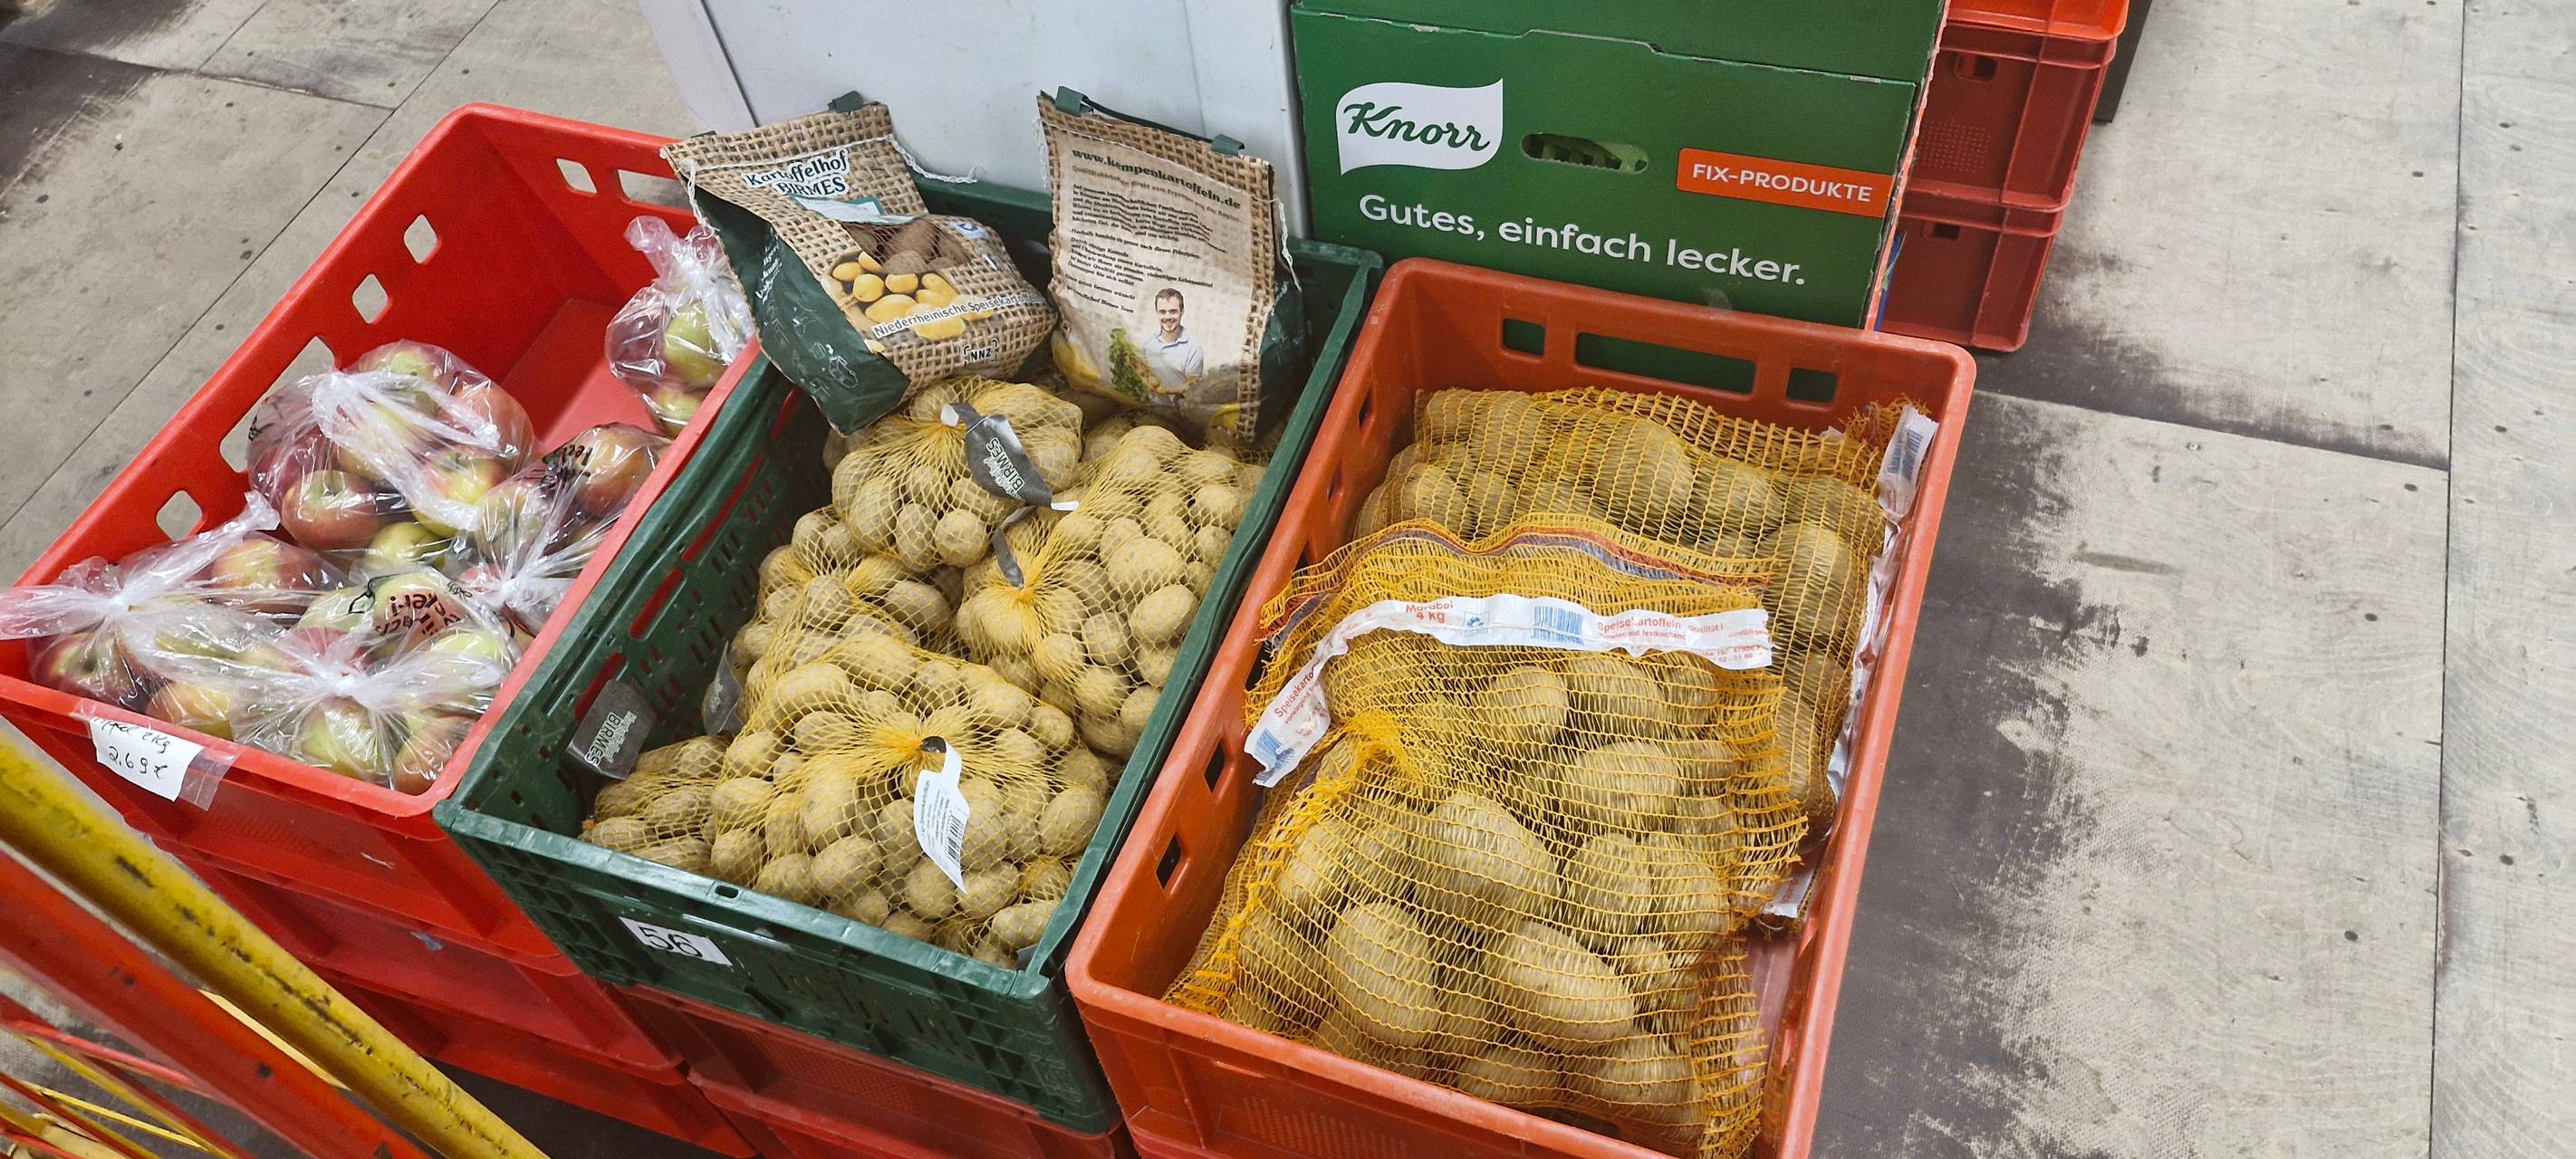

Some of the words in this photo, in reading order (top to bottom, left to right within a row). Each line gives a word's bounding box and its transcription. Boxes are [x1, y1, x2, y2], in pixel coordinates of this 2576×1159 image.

[1343, 102, 1491, 151] Knorr
[745, 149, 849, 187] Kartoffelhof
[776, 177, 847, 196] BIRMES
[1072, 149, 1241, 209] www.kempenkartoffeln.de
[1691, 162, 1874, 203] FIX-PRODUKTE
[1359, 194, 1485, 242] Gutes,
[1498, 217, 1651, 263] einfach
[1667, 238, 1806, 286] lecker.
[873, 304, 967, 339] Niederrheinische
[970, 348, 993, 361] NNZ
[987, 439, 1024, 491] BIRMES
[1416, 611, 1424, 620] 4
[1428, 611, 1446, 624] kg
[584, 712, 622, 767] BIRMES
[638, 925, 703, 957] 56
